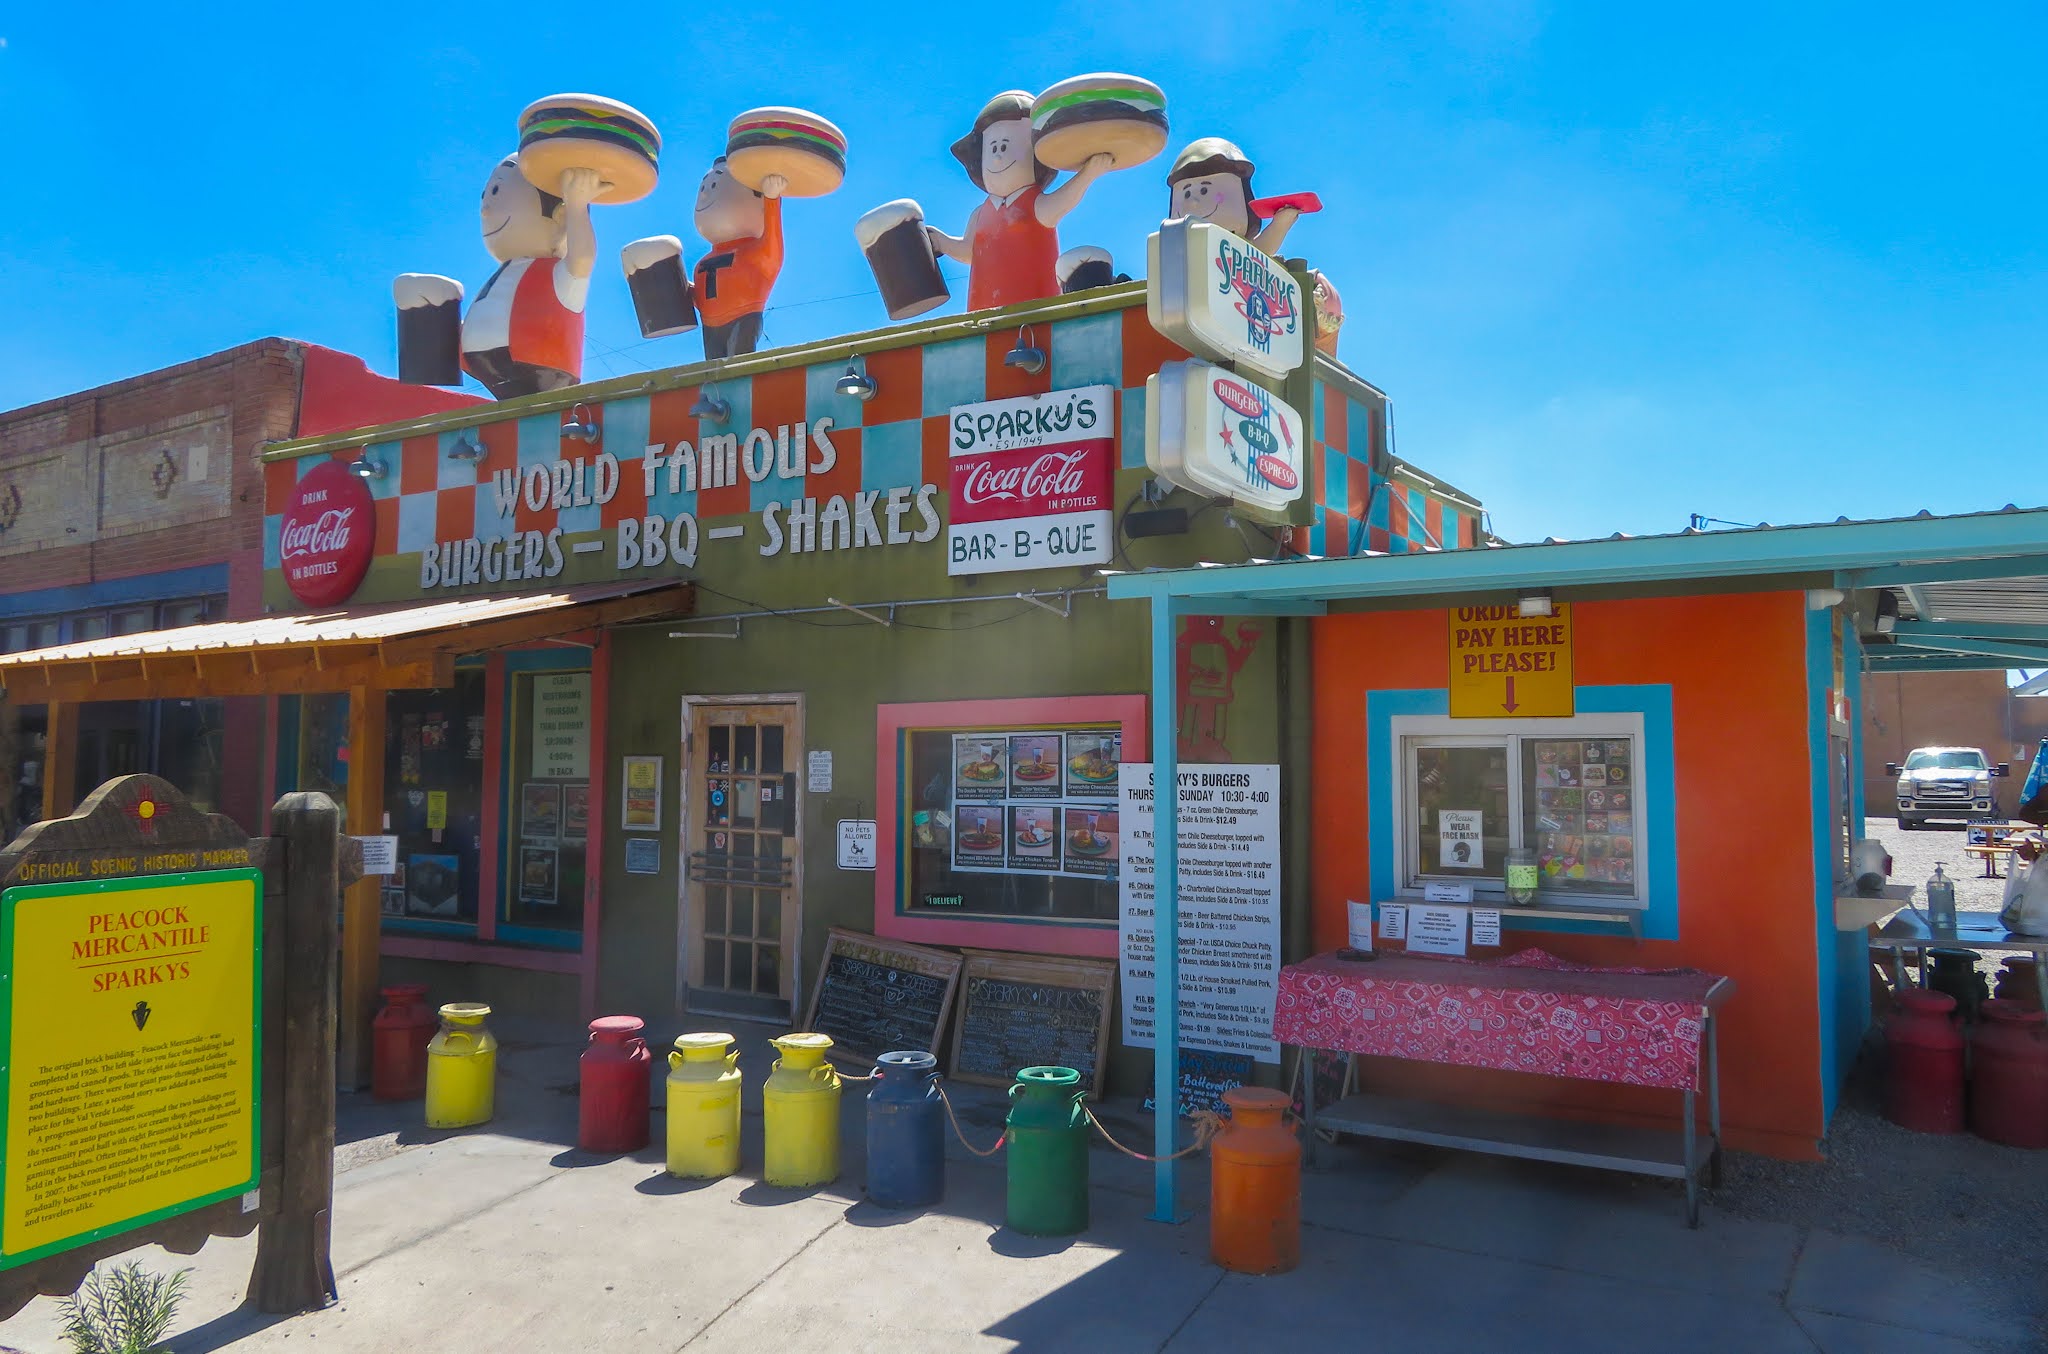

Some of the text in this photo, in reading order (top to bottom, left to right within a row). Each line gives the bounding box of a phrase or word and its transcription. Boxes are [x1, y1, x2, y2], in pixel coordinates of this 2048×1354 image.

[1219, 238, 1295, 334] SPARKYS
[1218, 382, 1259, 414] BURGERS
[954, 394, 1096, 449] SPARKY'S
[1248, 424, 1269, 445] B-B-Q
[493, 416, 837, 519] WORLD FAMOUS
[955, 463, 975, 472] DRINK
[964, 448, 1089, 504] Coca-Cola
[1259, 458, 1295, 485] ESPRESSO
[303, 490, 327, 504] DRINK
[1048, 496, 1097, 509] IN BOTTLES
[281, 507, 355, 559] Coca-Cola
[421, 484, 941, 589] BURGERS BBQ SHAKES
[293, 562, 337, 580] IN BOTTLES
[1458, 606, 1536, 622] ORDE
[1456, 625, 1565, 648] PAY HERE
[1464, 652, 1556, 673] PLEASE!
[545, 706, 578, 716] THURSDAY
[556, 768, 574, 776] BACK
[1202, 774, 1250, 787] BURGERS
[1180, 790, 1214, 801] SUNDAY
[1222, 791, 1244, 802] 10:30
[1250, 791, 1269, 802] 4:00
[1224, 808, 1258, 816] Cheeseburger,
[1446, 813, 1473, 822] Please
[1200, 833, 1235, 842] Cheeseburger,
[20, 850, 249, 880] OFFICIAL SCENIC HISTORIC MARKER
[1192, 859, 1224, 867] Cheeseburger
[89, 906, 189, 934] PEACOCK
[1210, 913, 1232, 921] Battered
[1233, 914, 1253, 922] Chicken
[72, 926, 210, 960] MERCANTILE
[1191, 948, 1272, 960] Chicken Breast smothered with
[93, 962, 189, 992] SPARKYS
[1220, 976, 1241, 985] Smoked
[1242, 978, 1258, 986] Pulled
[1038, 988, 1086, 1012] DRINKS
[1215, 1002, 1239, 1012] Generous
[1217, 1012, 1249, 1022] Side Drink
[54, 1035, 202, 1071] original building Peacock Mercantile
[1186, 1036, 1272, 1052] Espresso Shakes Lemonades
[30, 1051, 226, 1101] groceries canned featured clothes
[30, 1072, 68, 1087] completed
[158, 1062, 225, 1083] pass-throughs linking
[111, 1072, 226, 1102] second meeting
[1188, 1094, 1209, 1104] drink
[45, 1094, 220, 1143] progression businesses occupied buildings
[33, 1106, 240, 1166] community Brunswick tables assorted
[26, 1122, 227, 1181] gaming would poker games
[103, 1139, 236, 1181] Family bought properties Sparkys
[108, 1154, 138, 1168] attended
[25, 1148, 236, 1216] gradually became popular destination locals
[41, 1207, 73, 1221] travelers
